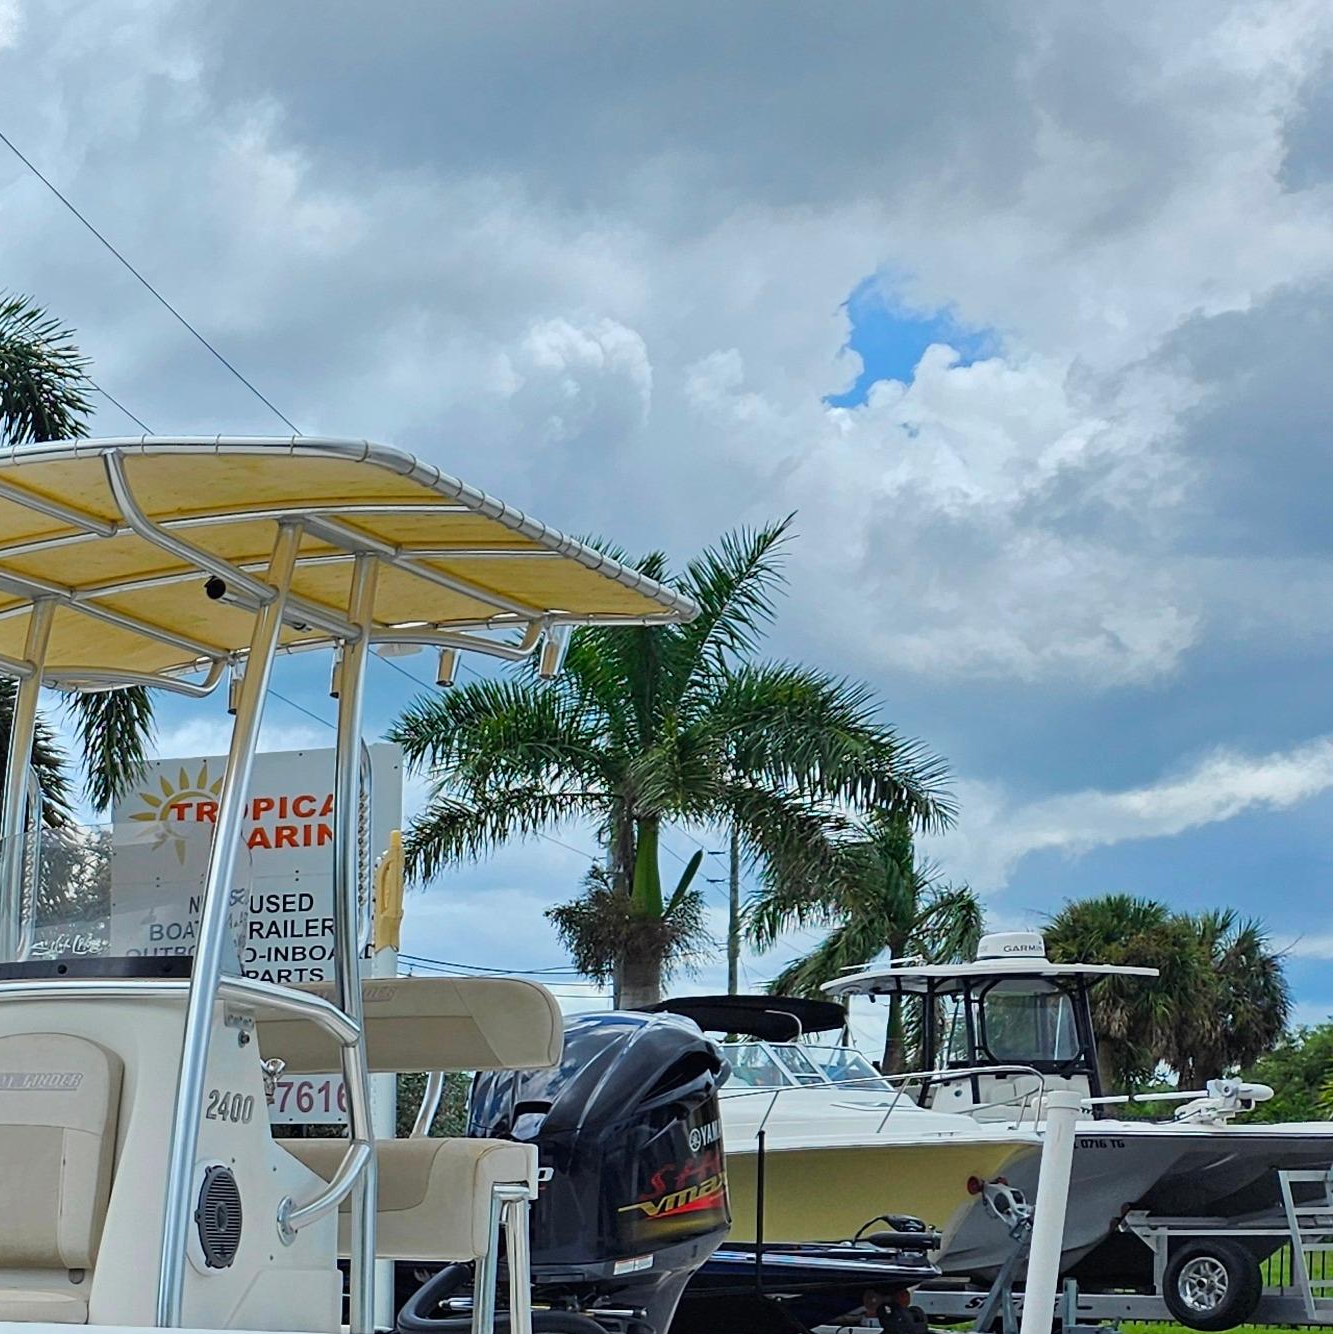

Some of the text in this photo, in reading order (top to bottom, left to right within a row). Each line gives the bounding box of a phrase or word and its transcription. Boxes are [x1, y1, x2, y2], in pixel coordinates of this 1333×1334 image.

[168, 793, 334, 823] TRPICA
[212, 822, 334, 849] ARIN
[249, 893, 314, 914] USED
[248, 917, 334, 940] RAILER
[245, 968, 324, 984] PARTS
[205, 1089, 255, 1125] 2400
